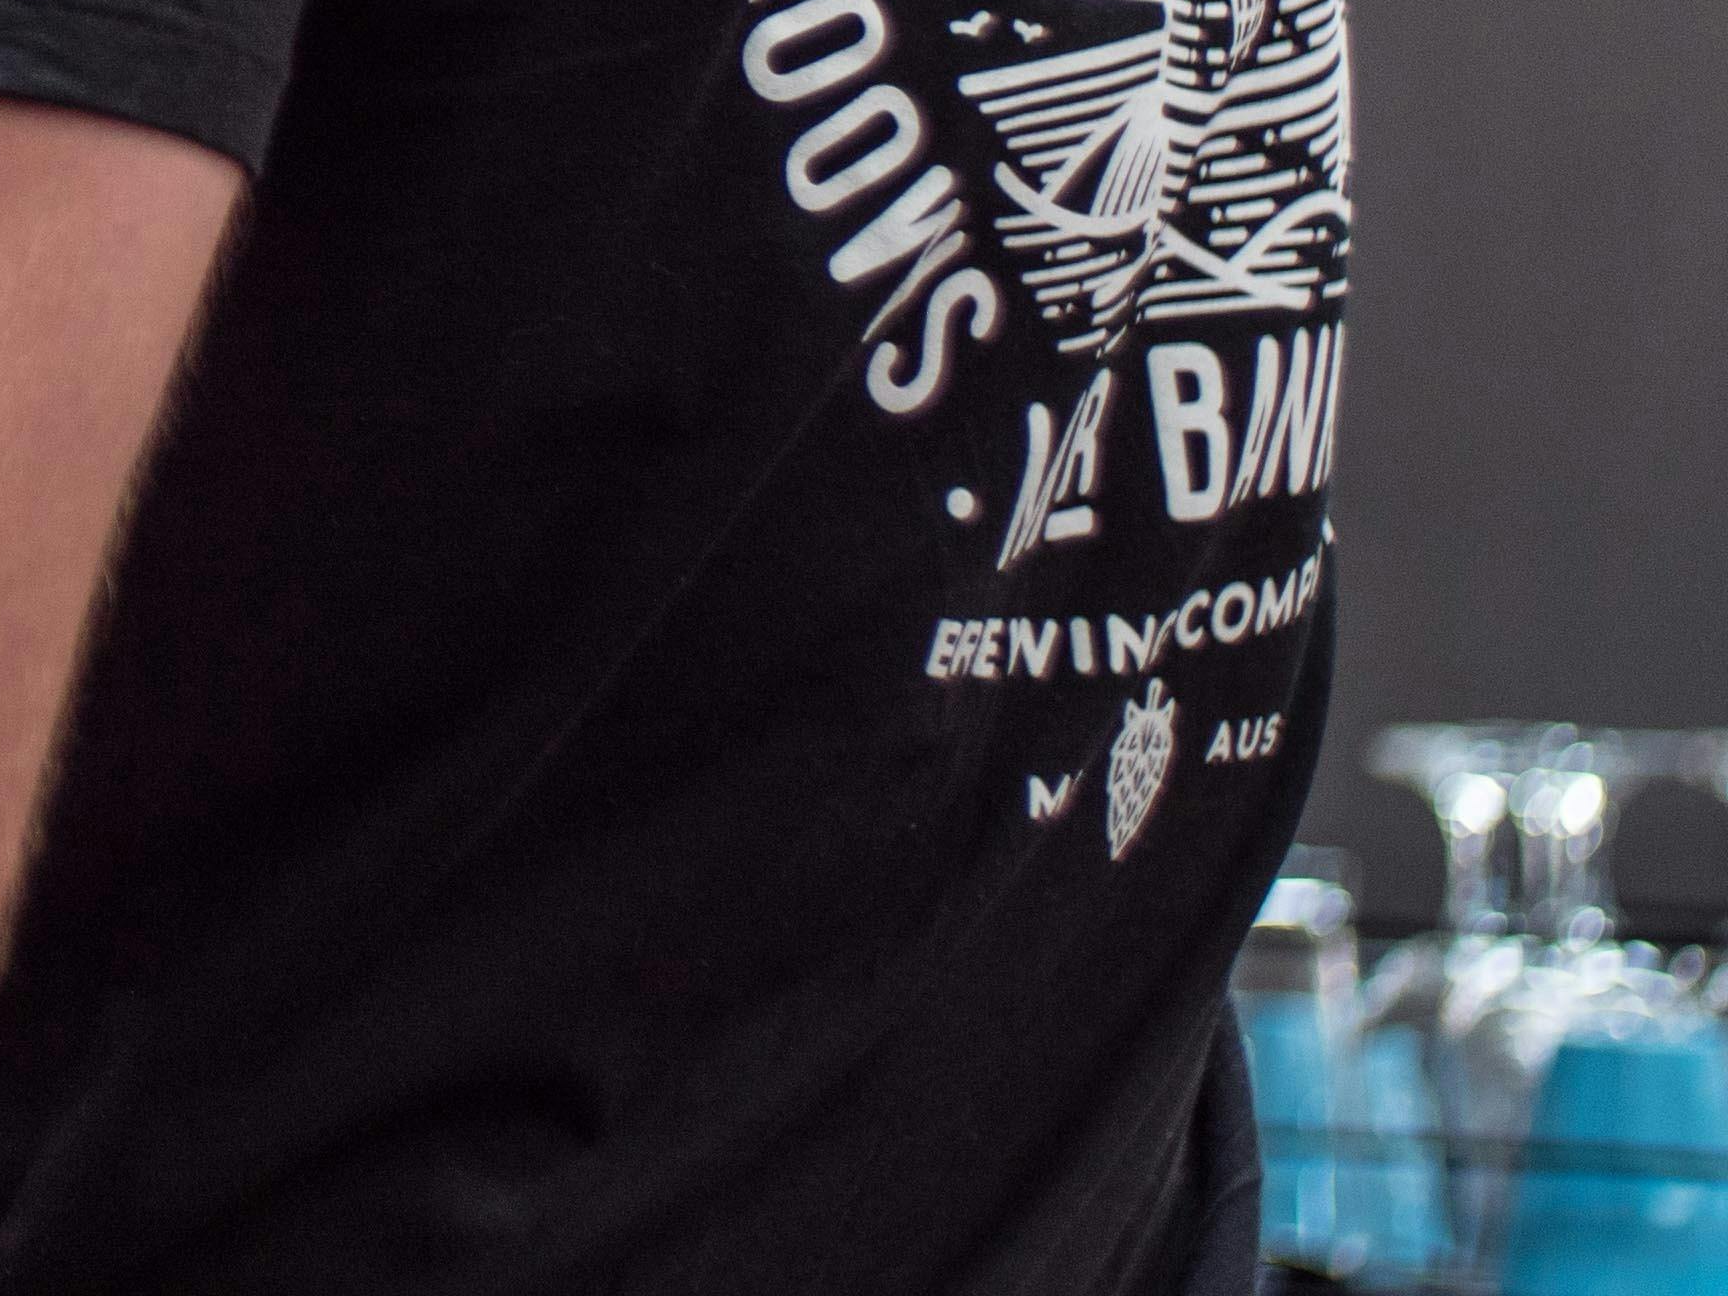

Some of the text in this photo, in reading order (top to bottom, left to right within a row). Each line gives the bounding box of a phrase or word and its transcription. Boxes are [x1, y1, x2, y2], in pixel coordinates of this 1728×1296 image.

[1147, 318, 1343, 522] BAN
[925, 608, 1179, 681] BREWIN
[1205, 711, 1282, 764] AUS
